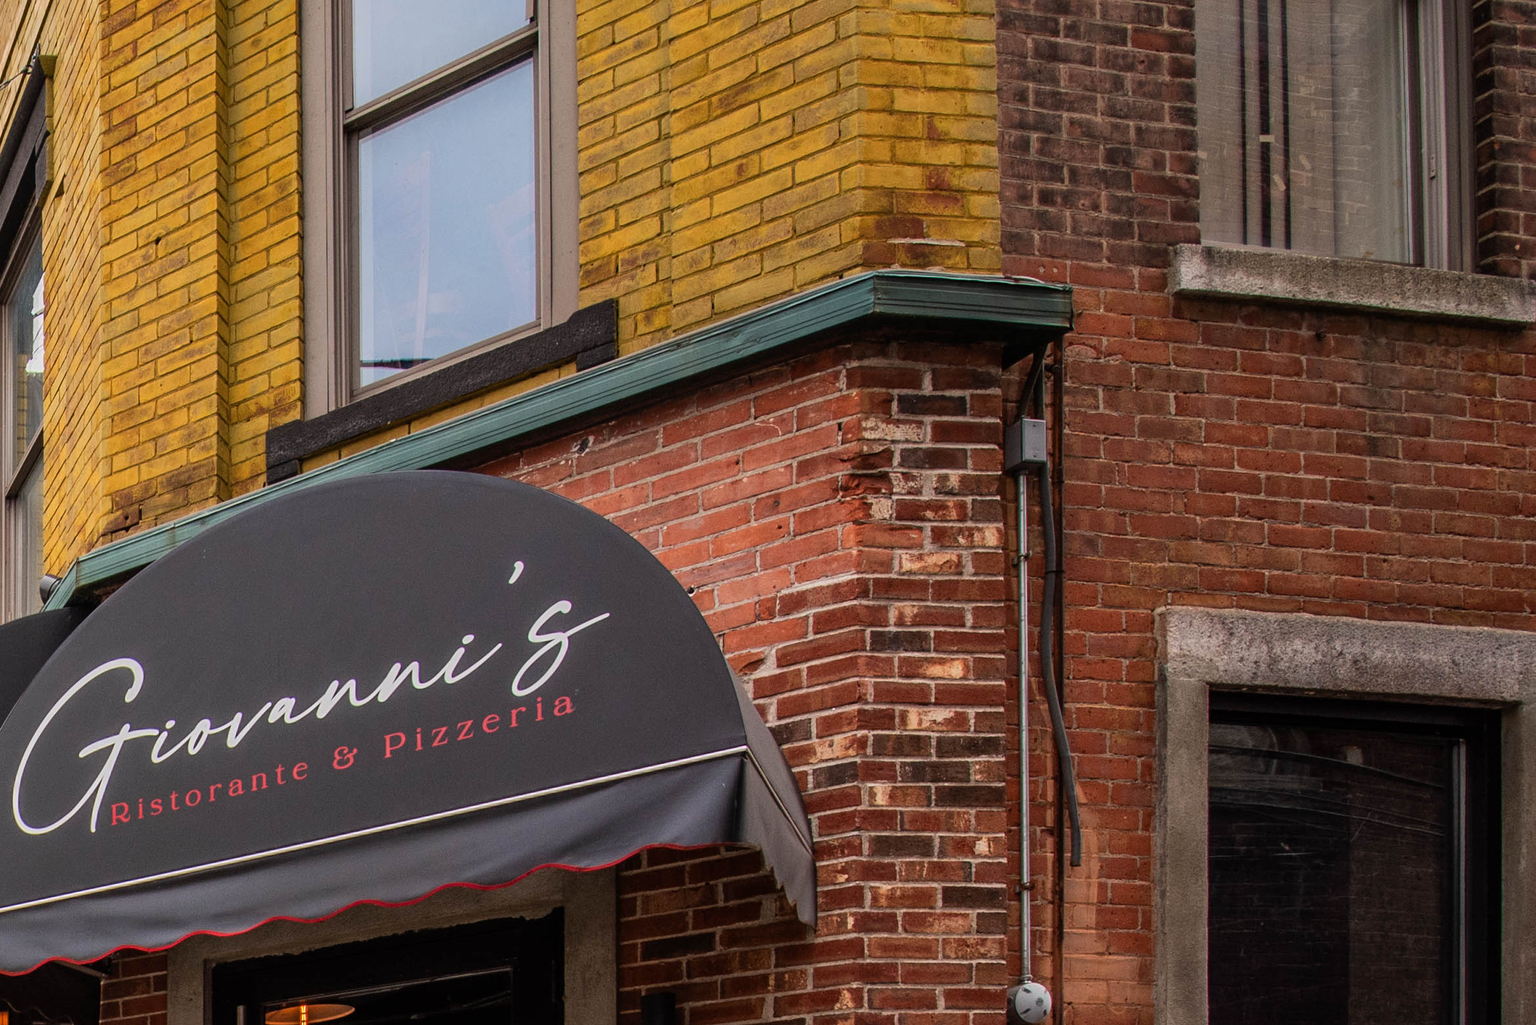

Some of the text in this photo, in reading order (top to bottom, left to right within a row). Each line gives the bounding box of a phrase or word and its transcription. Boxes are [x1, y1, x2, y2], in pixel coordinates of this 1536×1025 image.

[12, 561, 611, 835] Giovanni's
[110, 695, 576, 827] Ristorante & Pizzeria
